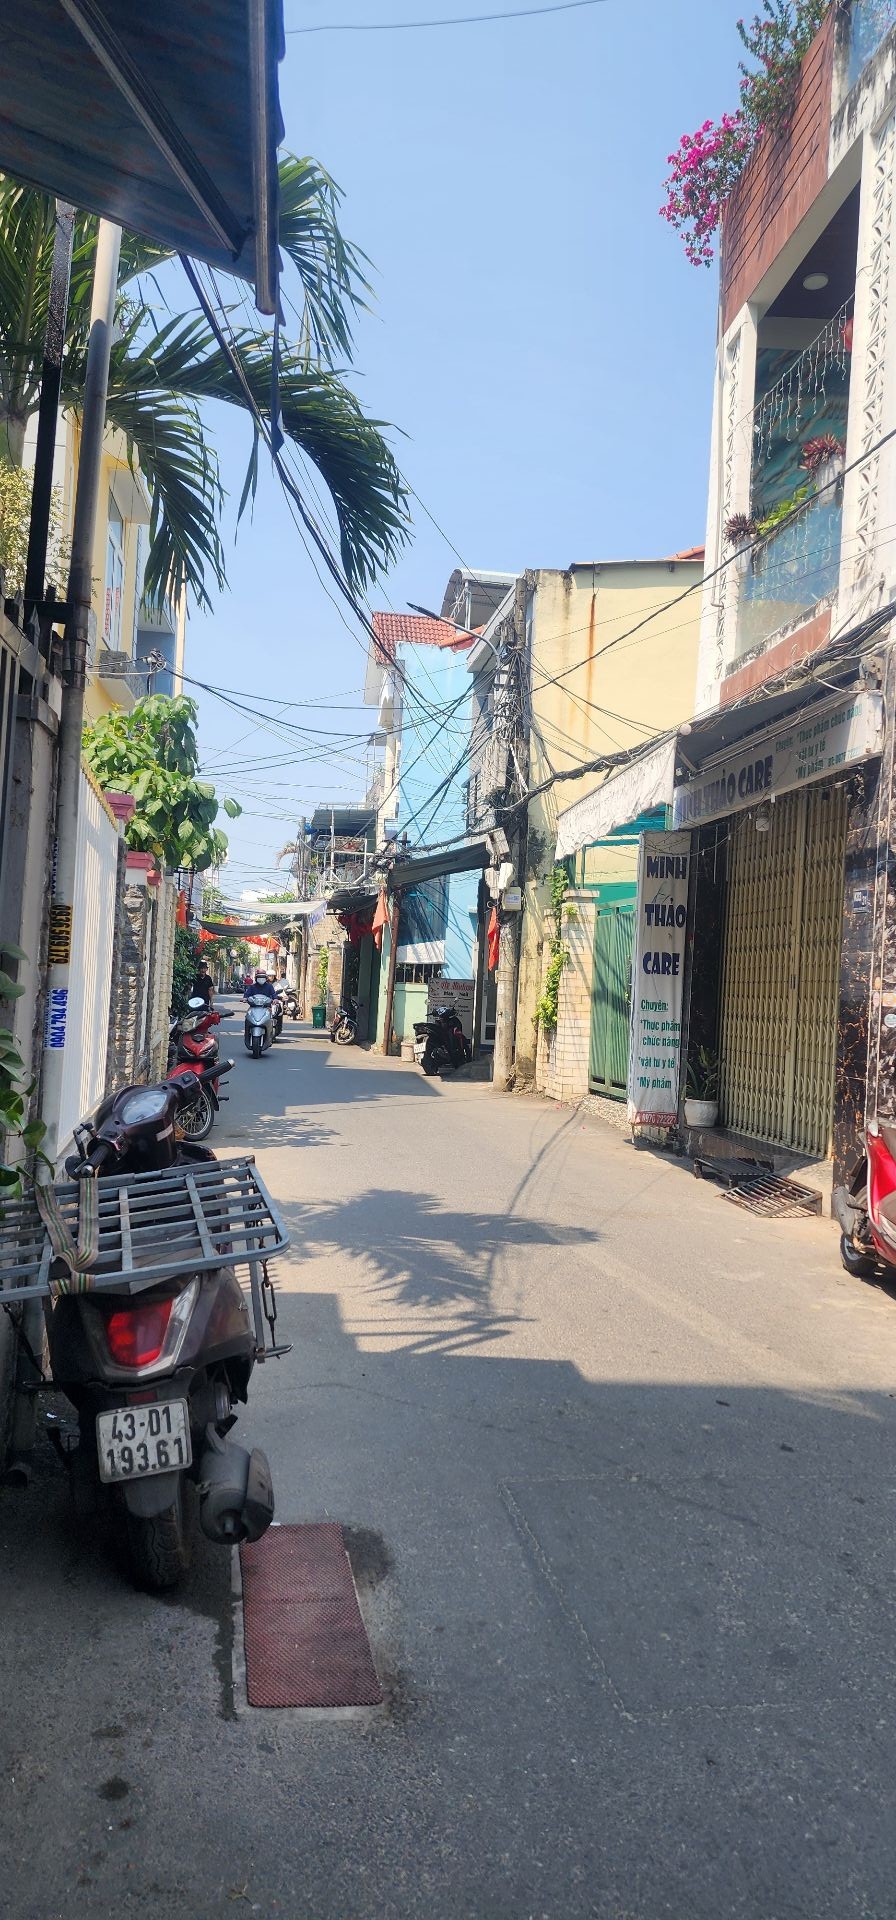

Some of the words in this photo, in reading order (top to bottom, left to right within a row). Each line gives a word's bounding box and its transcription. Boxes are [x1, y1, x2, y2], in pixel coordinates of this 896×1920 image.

[703, 768, 736, 814] THẢO
[738, 755, 773, 799] CARE
[646, 856, 688, 879] MINH
[644, 897, 687, 928] THẢO
[642, 951, 680, 976] CARE
[640, 999, 669, 1012] Chuyên:
[661, 1018, 680, 1032] phẩm
[642, 1035, 660, 1047] chức
[661, 1036, 680, 1049] năng
[667, 1055, 676, 1068] tế
[651, 1075, 672, 1089] phẩm
[111, 1405, 172, 1443] 43-D1
[106, 1437, 184, 1477] 193.61
